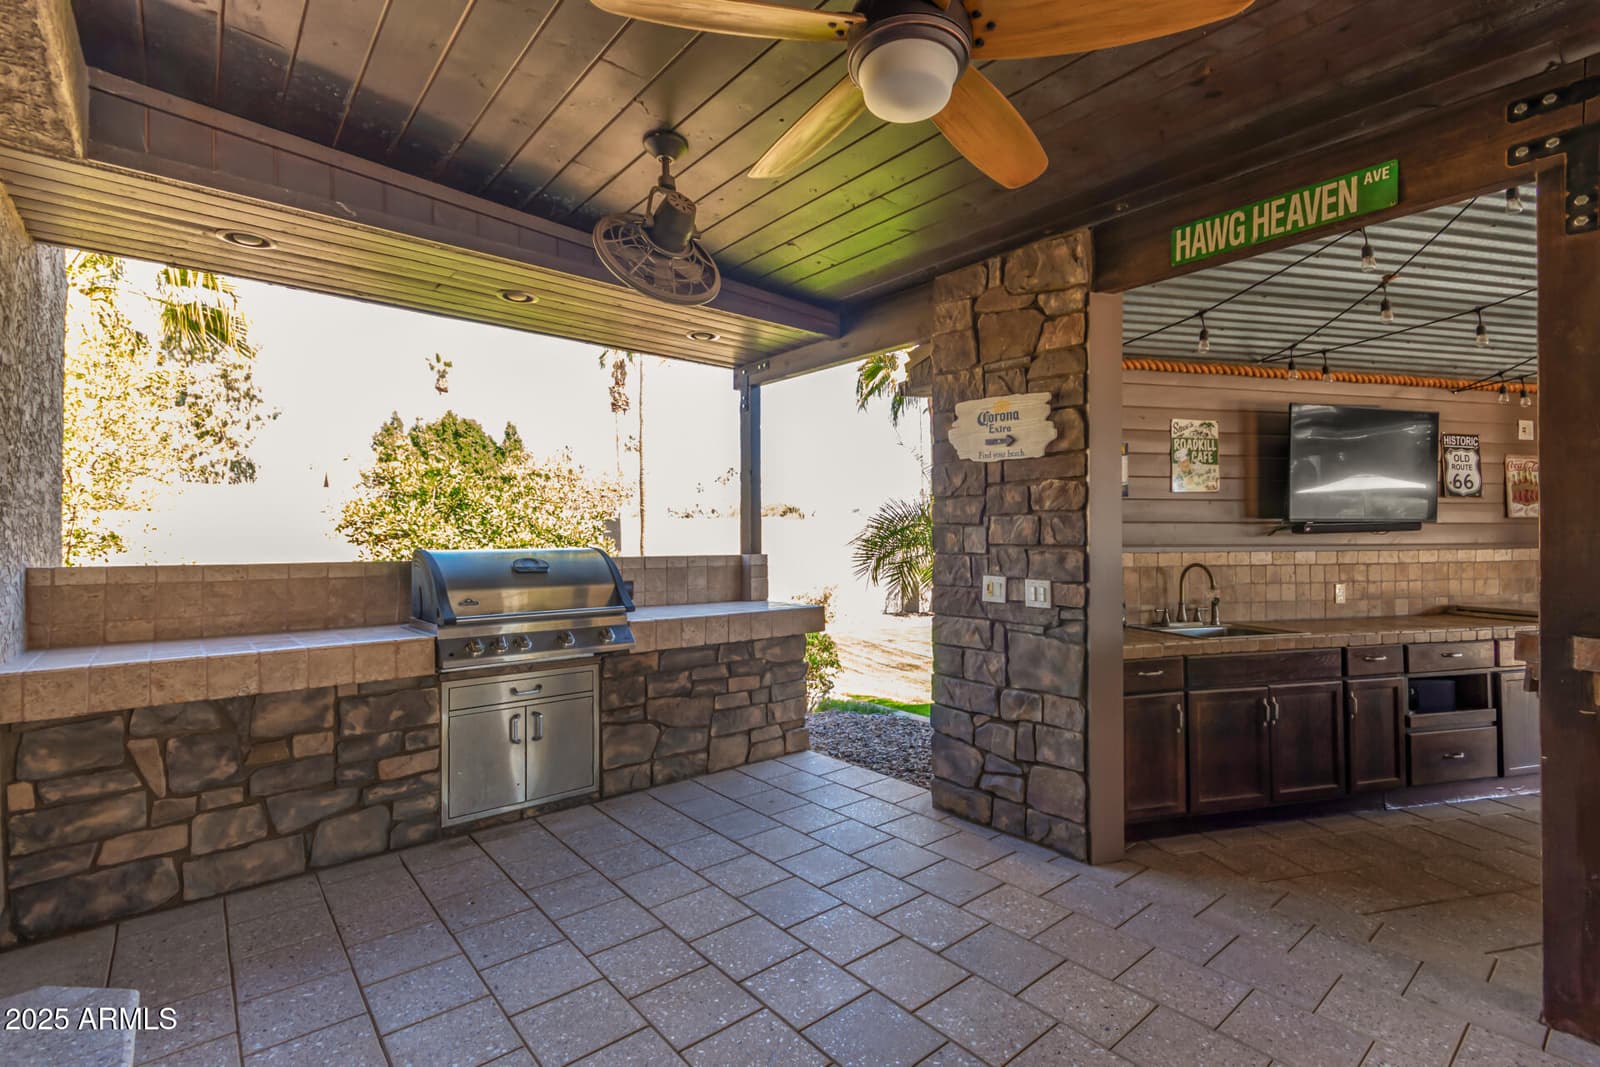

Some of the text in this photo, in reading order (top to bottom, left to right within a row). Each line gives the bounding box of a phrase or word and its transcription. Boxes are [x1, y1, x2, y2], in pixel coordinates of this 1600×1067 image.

[1175, 165, 1390, 262] HAWG HEAVEN AVE
[977, 410, 1019, 426] Corona
[988, 424, 1012, 434] Extra
[1173, 438, 1216, 451] ROADKILL
[1443, 435, 1479, 447] HISTORIC
[1191, 450, 1214, 463] CAFE
[1453, 453, 1470, 463] OLD
[1451, 463, 1473, 471] ROUTE
[1453, 473, 1474, 490] 66
